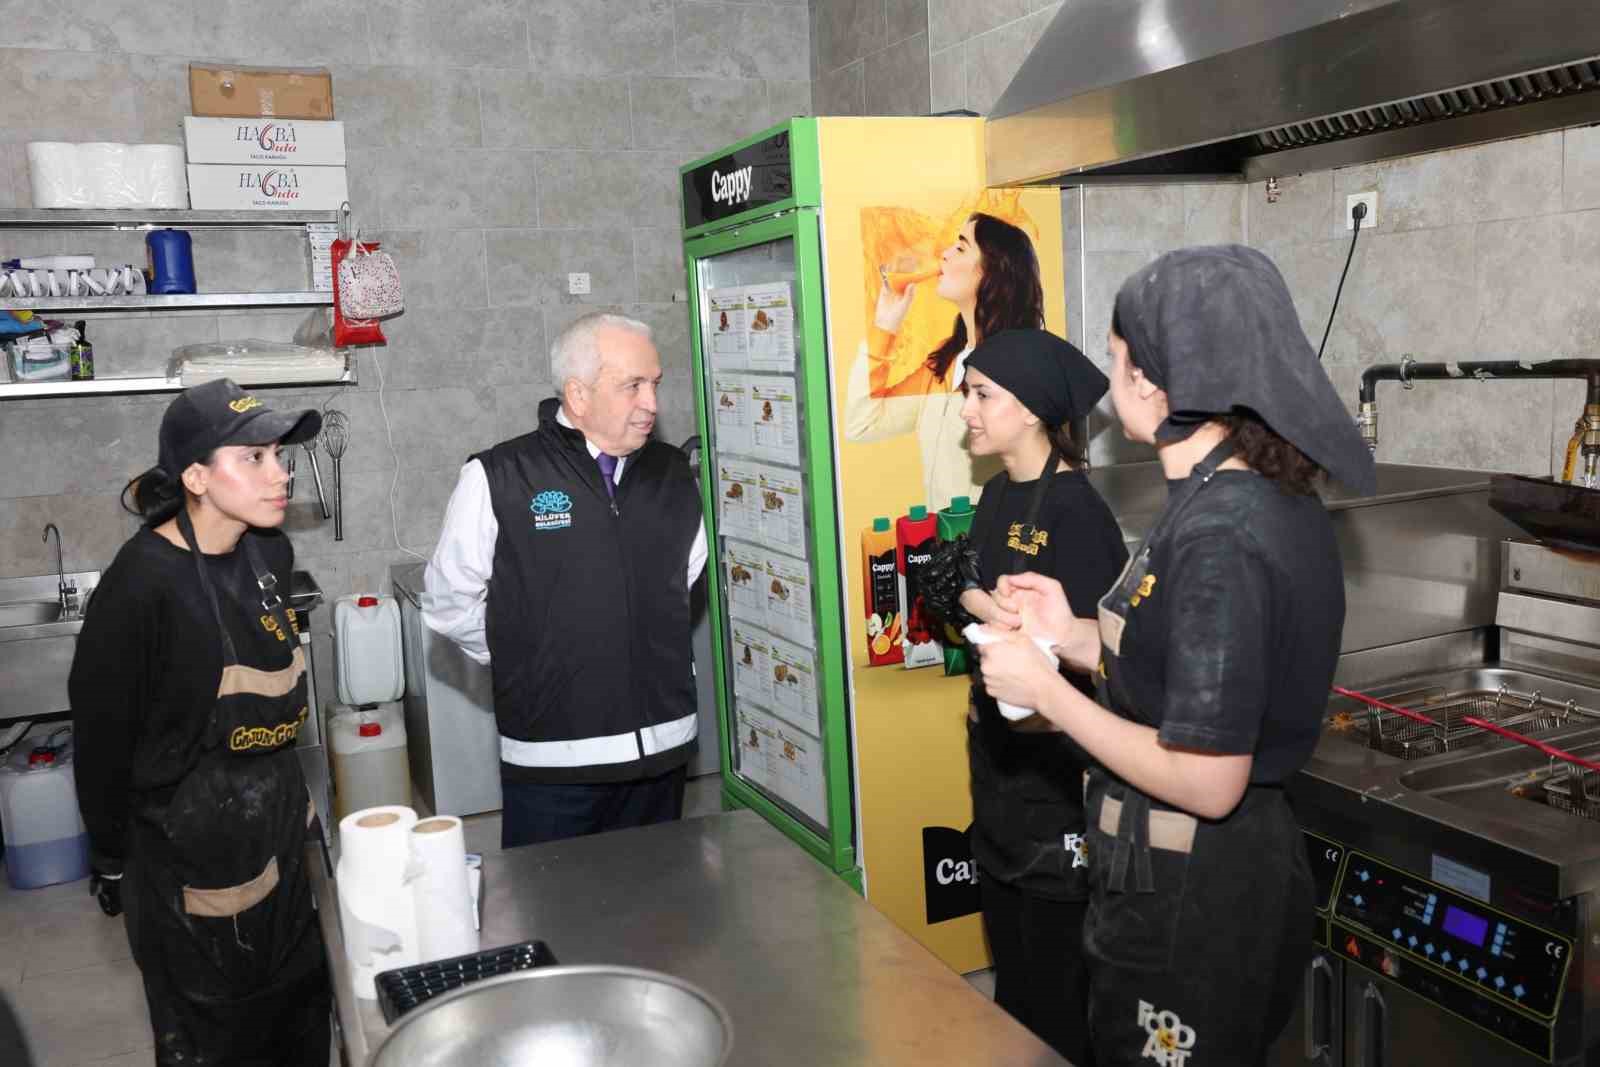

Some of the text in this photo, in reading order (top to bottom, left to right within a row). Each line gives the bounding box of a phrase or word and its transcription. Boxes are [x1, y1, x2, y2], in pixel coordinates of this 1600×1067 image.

[711, 165, 753, 206] Cappy
[872, 562, 895, 573] Cappy
[1137, 998, 1197, 1049] FOOD
